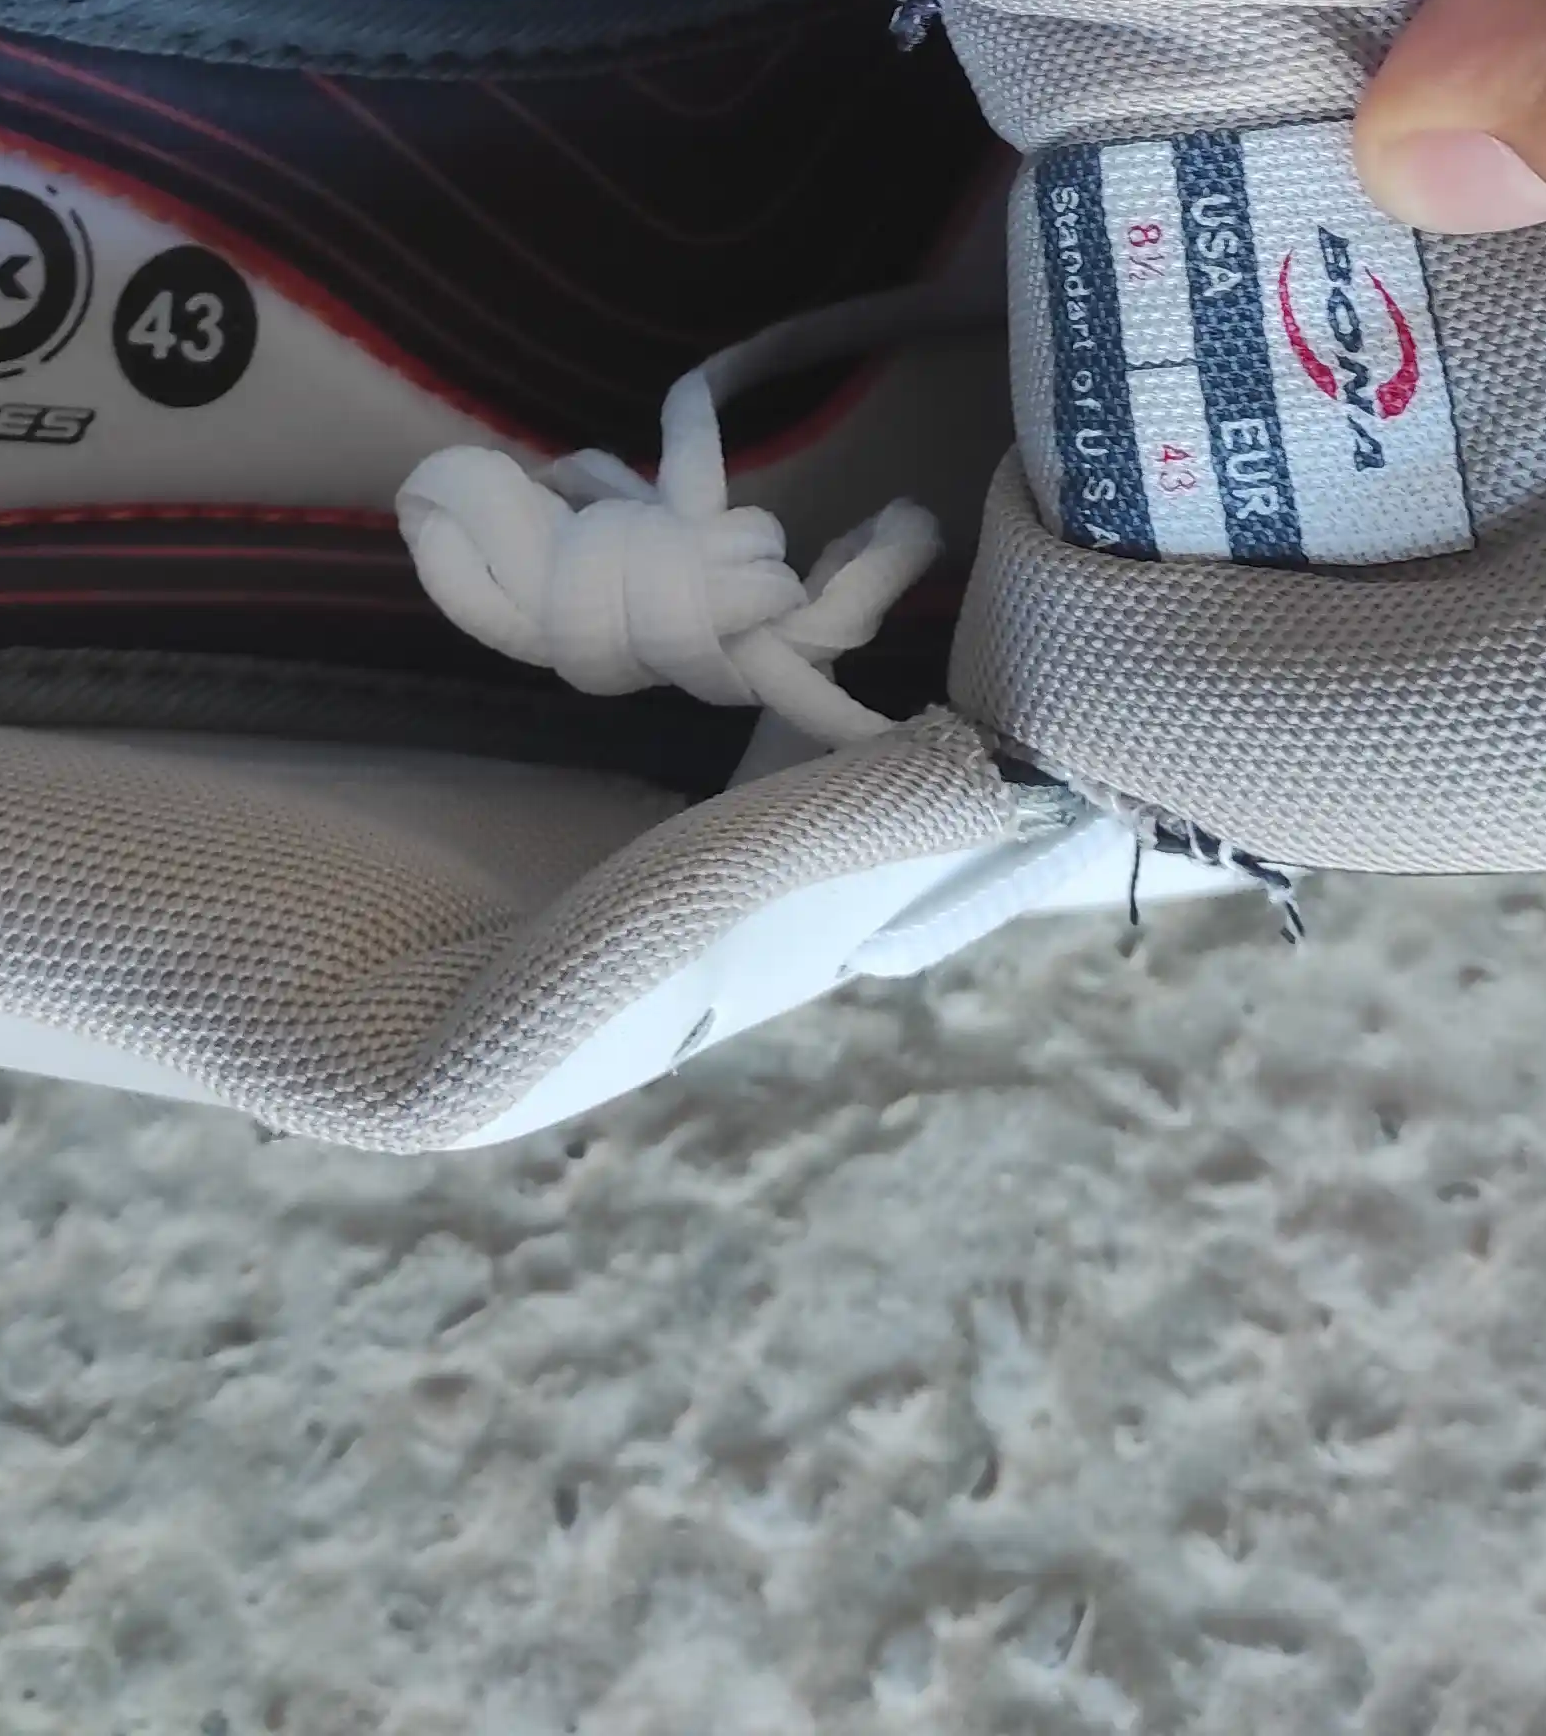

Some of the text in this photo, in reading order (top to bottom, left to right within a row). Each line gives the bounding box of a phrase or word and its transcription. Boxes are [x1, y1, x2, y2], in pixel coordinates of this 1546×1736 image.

[1190, 196, 1242, 298] USA
[127, 292, 226, 364] 43
[1319, 226, 1384, 470] BONA
[1156, 445, 1196, 495] 43
[1222, 419, 1278, 520] EUR
